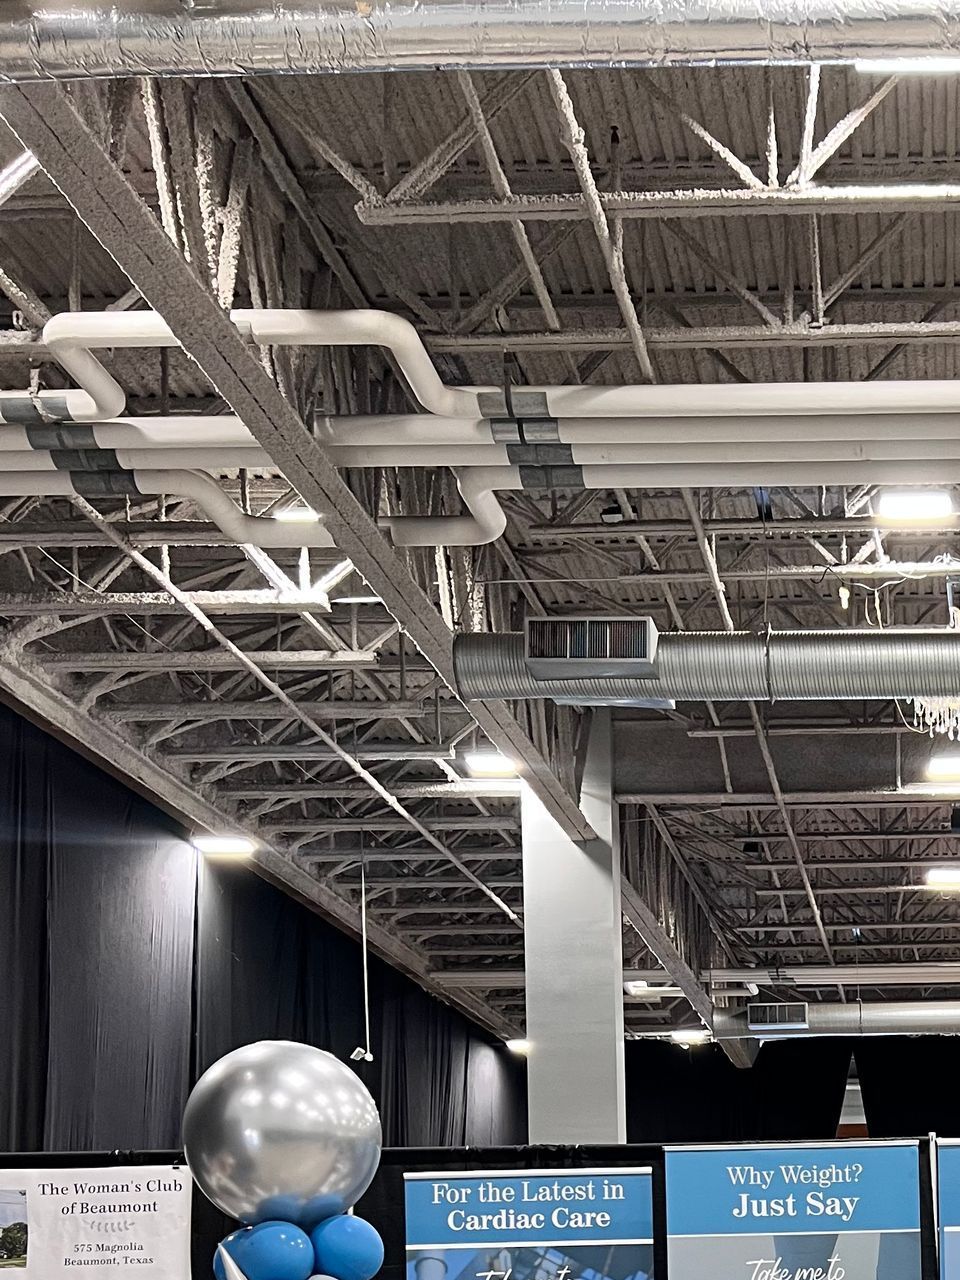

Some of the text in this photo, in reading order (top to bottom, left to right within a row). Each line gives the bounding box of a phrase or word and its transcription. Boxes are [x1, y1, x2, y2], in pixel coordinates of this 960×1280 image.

[38, 1180, 183, 1196] The Woman's Club
[726, 1164, 863, 1189] Why Weight?
[432, 1180, 625, 1204] For the Latest in
[62, 1201, 158, 1215] of Beaumont
[732, 1192, 860, 1221] Just Say
[448, 1208, 611, 1231] Cardiac Care
[74, 1242, 144, 1253] 575 Magnolia
[64, 1256, 154, 1266] Beaumont, Texas
[827, 1253, 845, 1280] to
